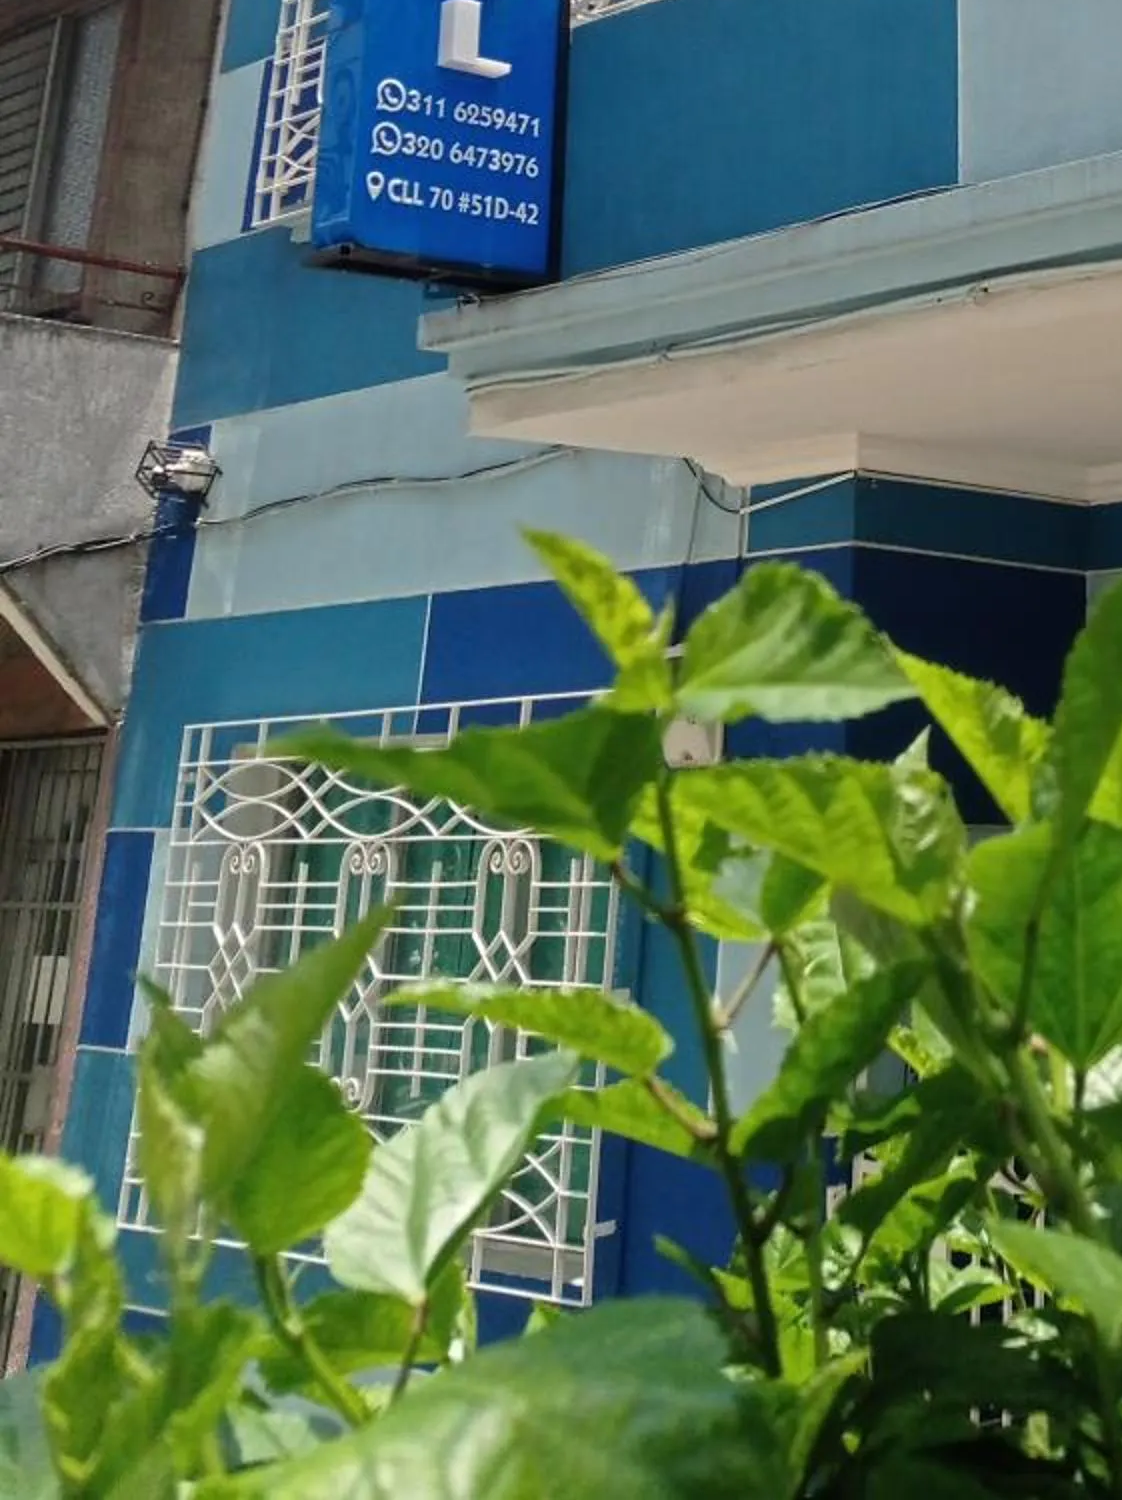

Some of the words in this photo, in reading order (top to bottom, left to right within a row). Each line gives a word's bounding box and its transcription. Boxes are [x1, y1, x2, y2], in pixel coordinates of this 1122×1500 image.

[405, 88, 446, 119] 311
[453, 101, 541, 138] 6259471
[401, 131, 444, 161] 320
[449, 141, 540, 179] 6473976
[387, 177, 424, 207] CLL
[429, 186, 454, 211] 70
[458, 191, 540, 226] #51D-42
